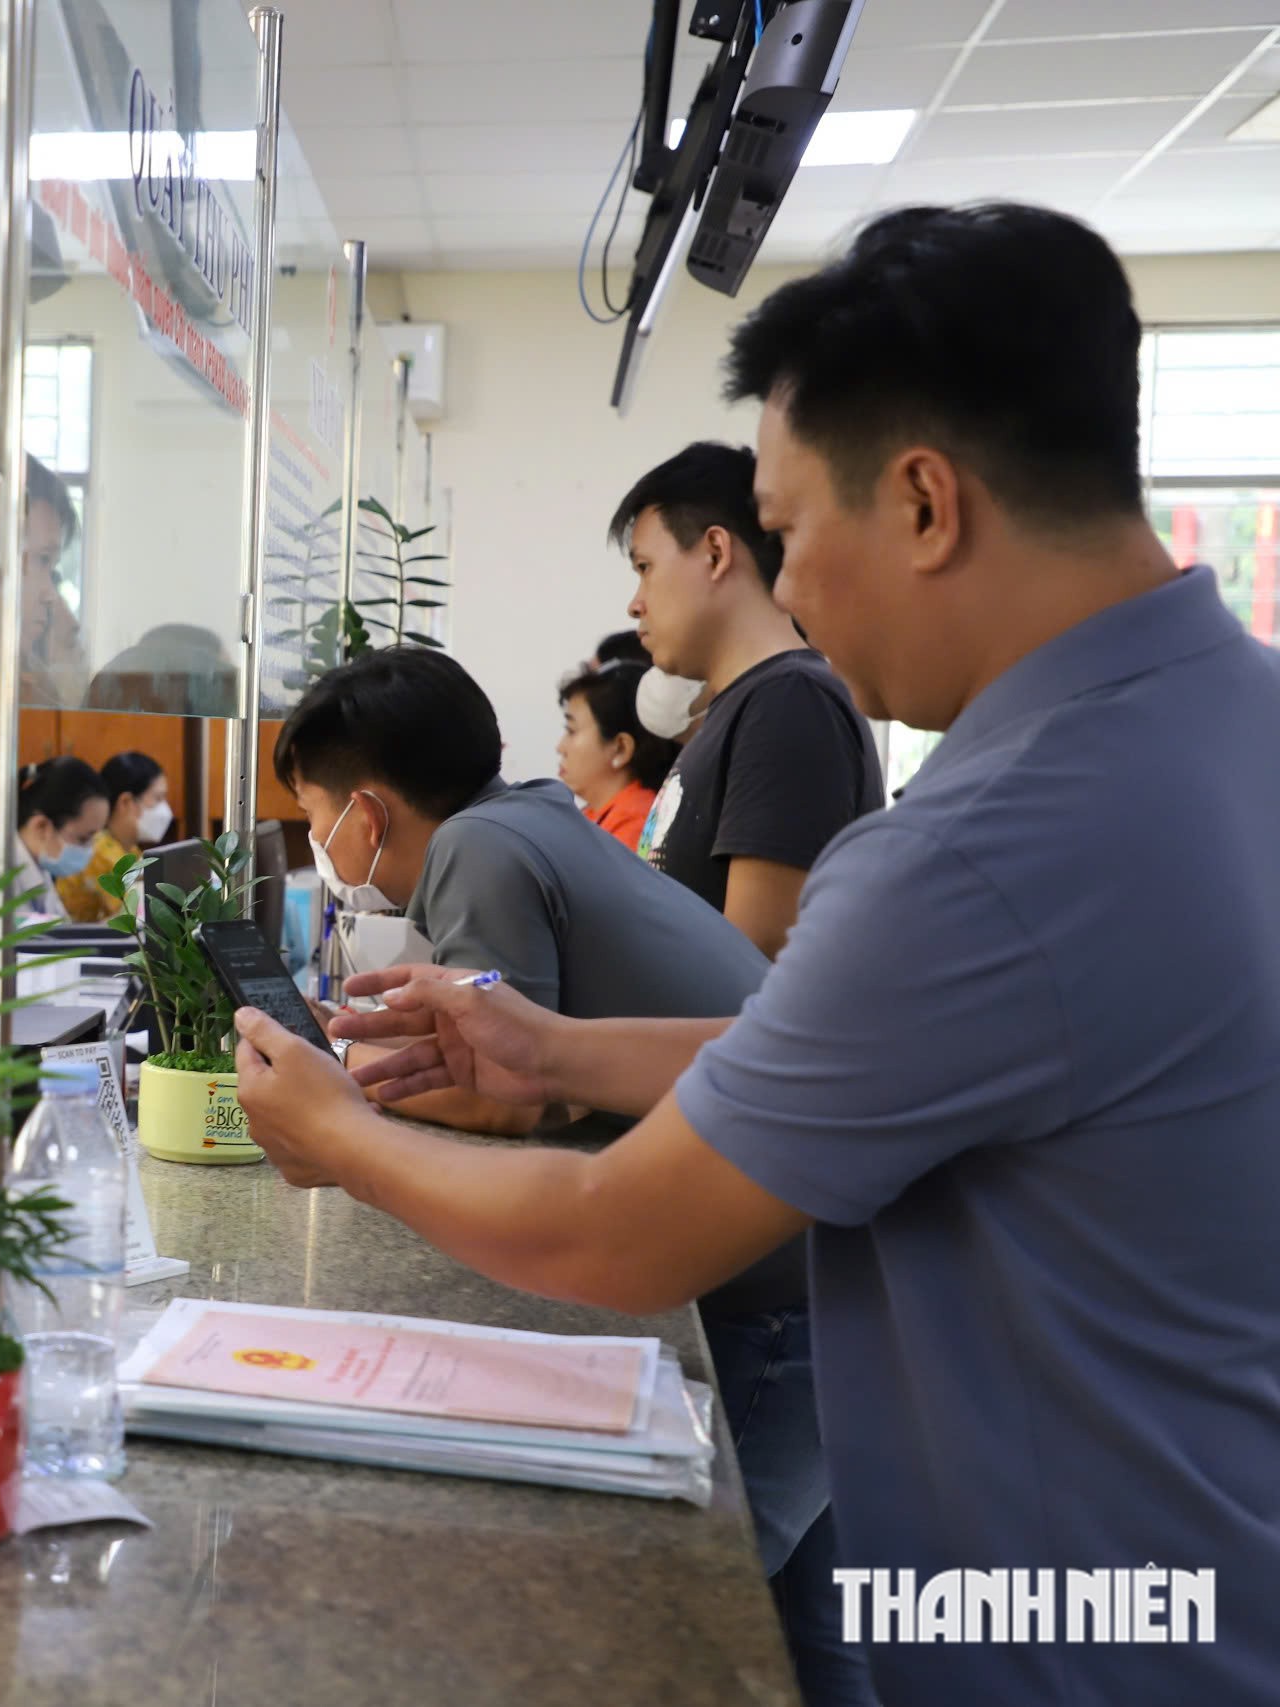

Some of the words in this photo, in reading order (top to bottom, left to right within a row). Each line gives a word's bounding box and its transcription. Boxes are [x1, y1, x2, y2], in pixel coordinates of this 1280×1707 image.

[57, 1050, 75, 1059] SCAN
[75, 1048, 84, 1056] TO
[85, 1046, 97, 1055] PAY
[216, 1106, 243, 1127] BIG
[206, 1127, 243, 1138] around
